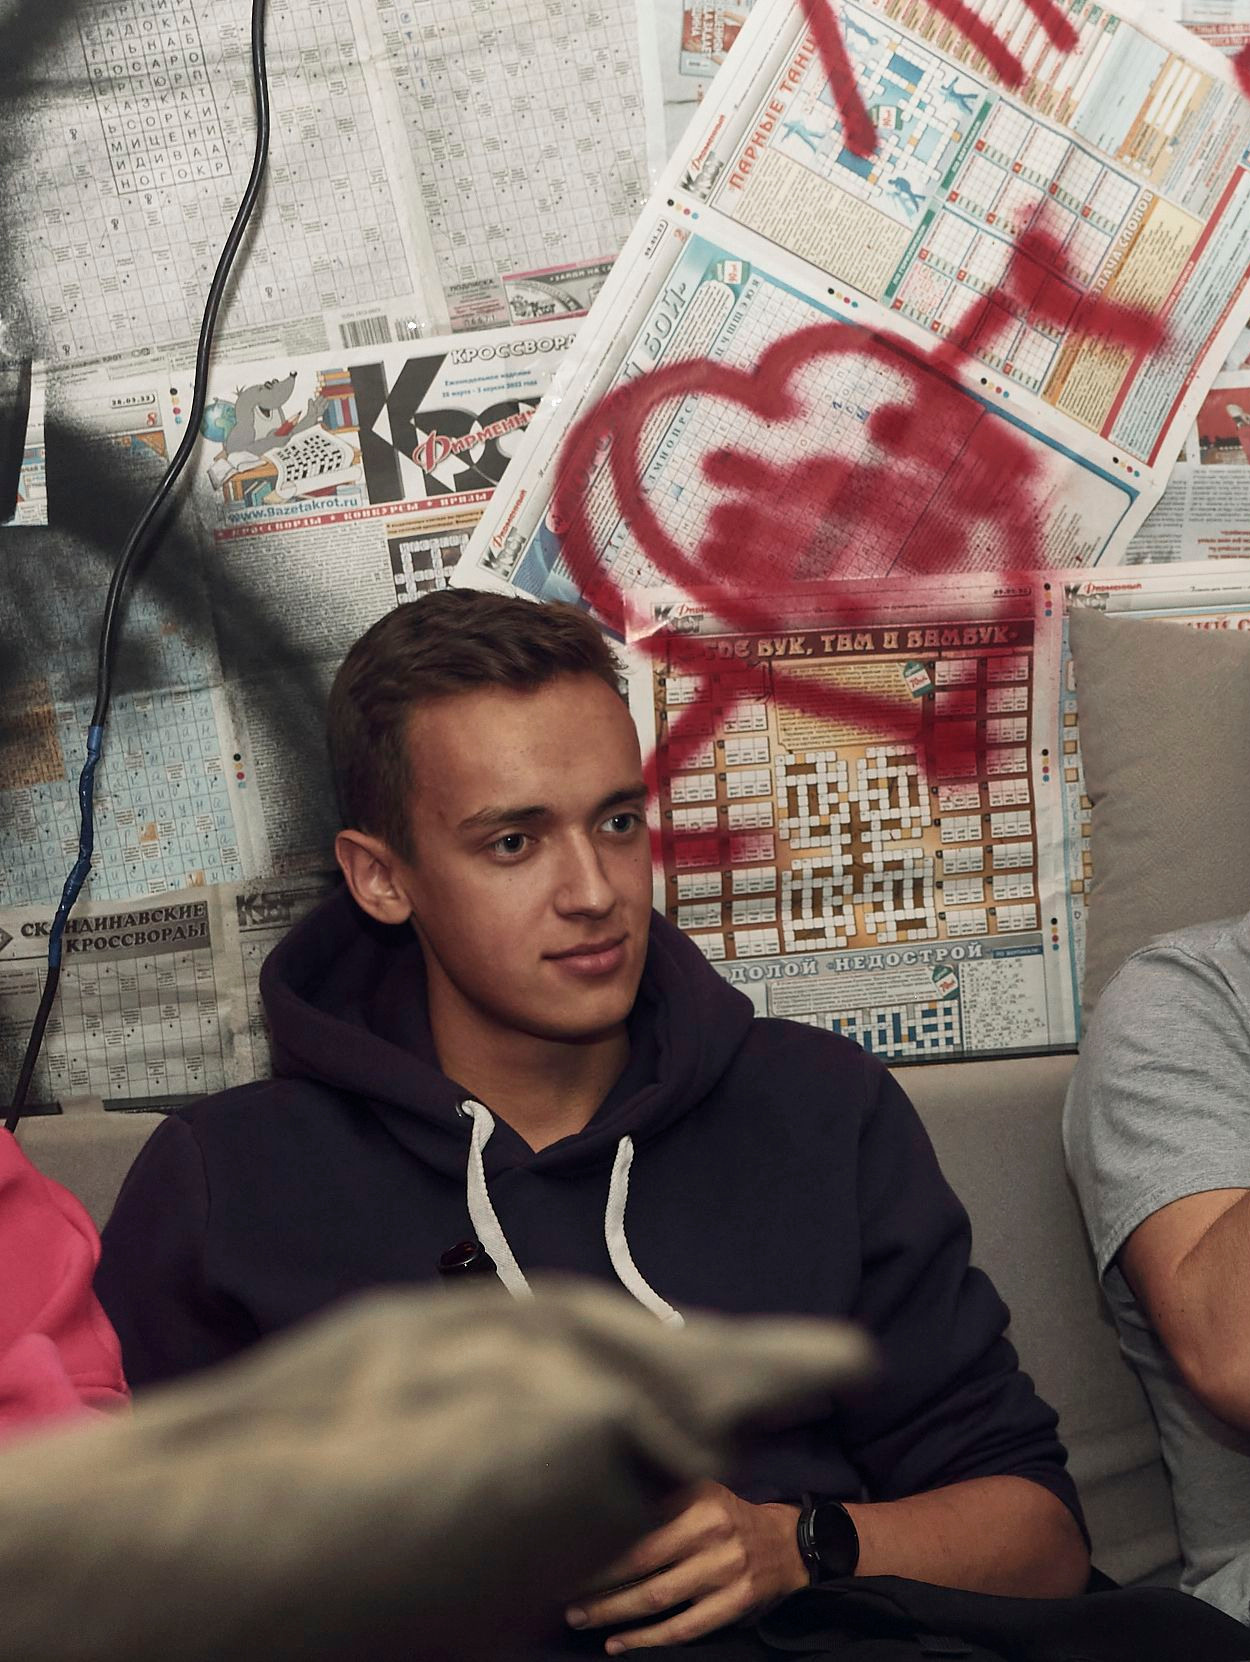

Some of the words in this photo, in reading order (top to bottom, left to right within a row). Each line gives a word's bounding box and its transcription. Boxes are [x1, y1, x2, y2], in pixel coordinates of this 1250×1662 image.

[730, 99, 785, 191] ПАРНЫЕ
[777, 26, 821, 94] ТАНЦ
[228, 496, 358, 523] www.gazetakrot.ru
[21, 902, 207, 938] СКНДИНАВСКИЕ
[66, 922, 207, 953] КРОССВОРДЫ
